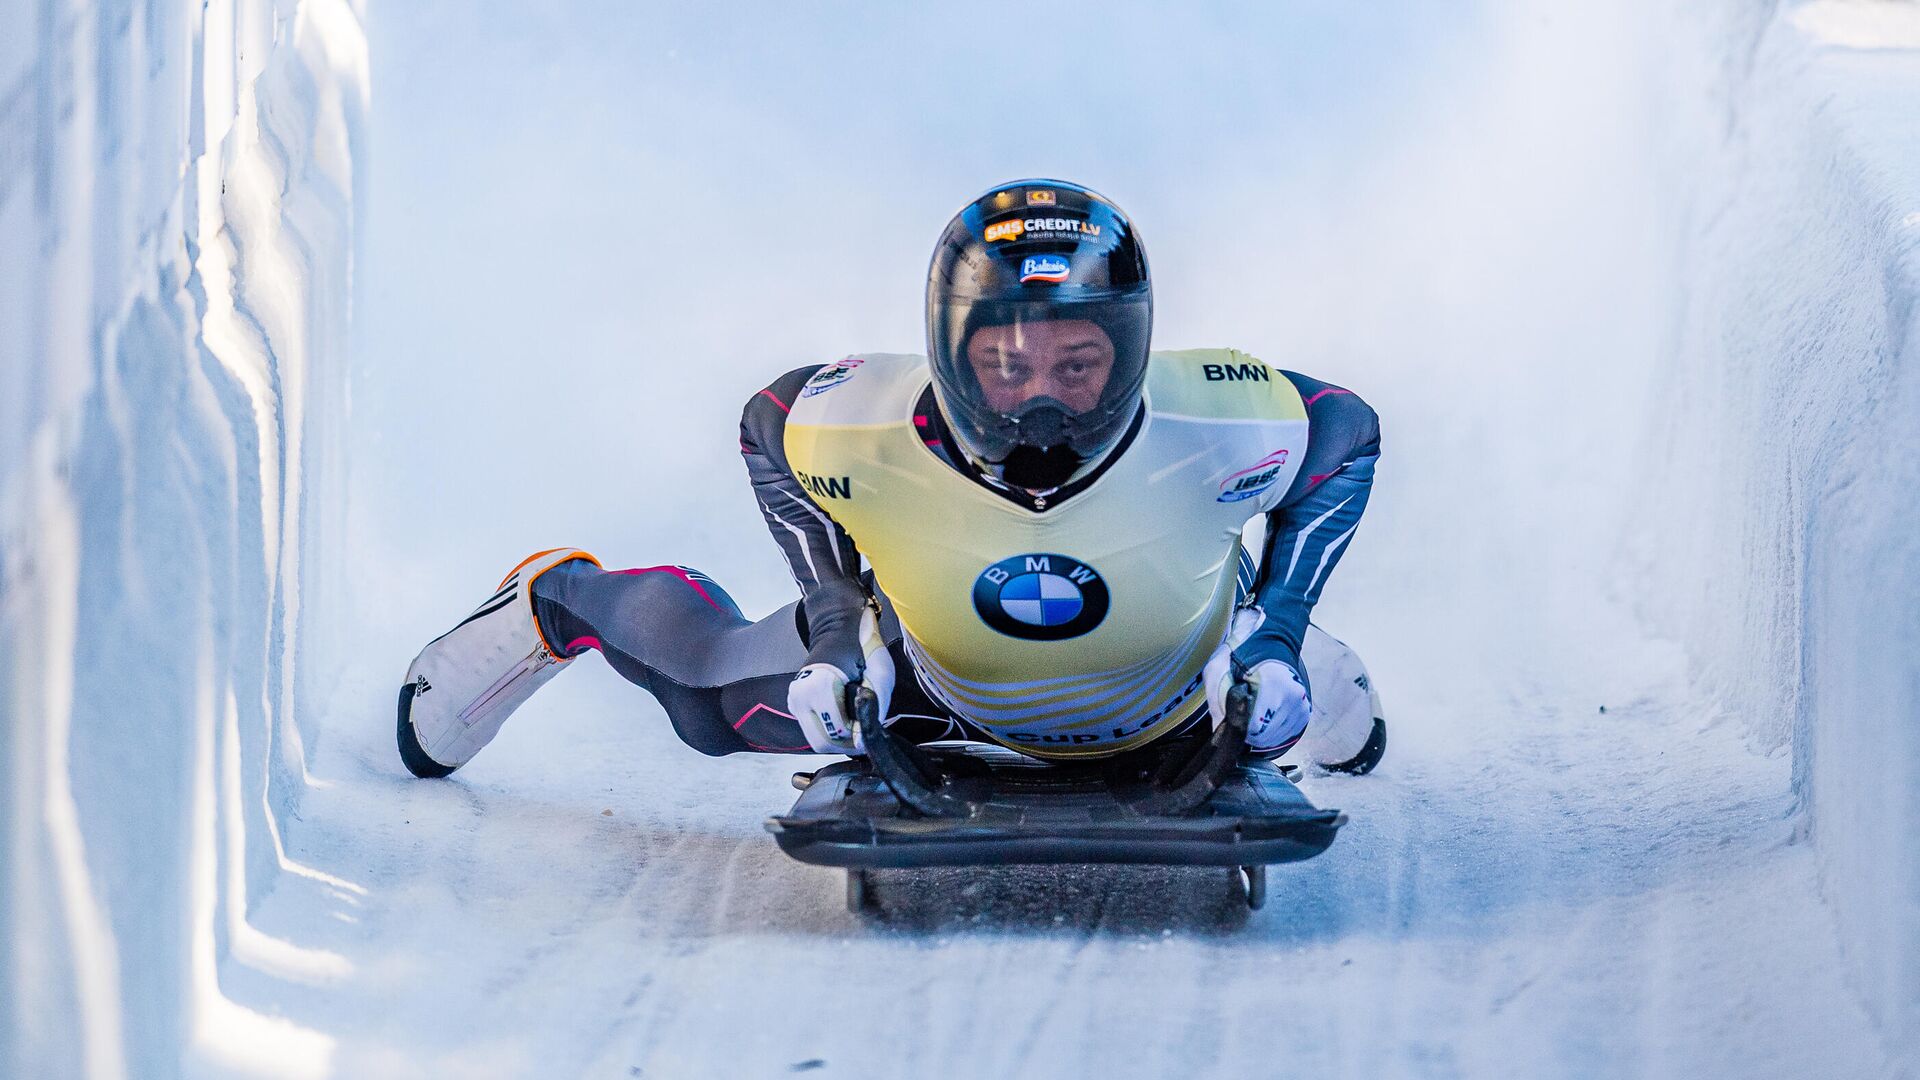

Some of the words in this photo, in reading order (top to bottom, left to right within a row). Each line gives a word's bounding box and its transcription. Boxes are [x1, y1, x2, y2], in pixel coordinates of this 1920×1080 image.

[1202, 363, 1269, 382] BMW
[984, 556, 1097, 586] BMW
[1006, 732, 1099, 744] Cup
